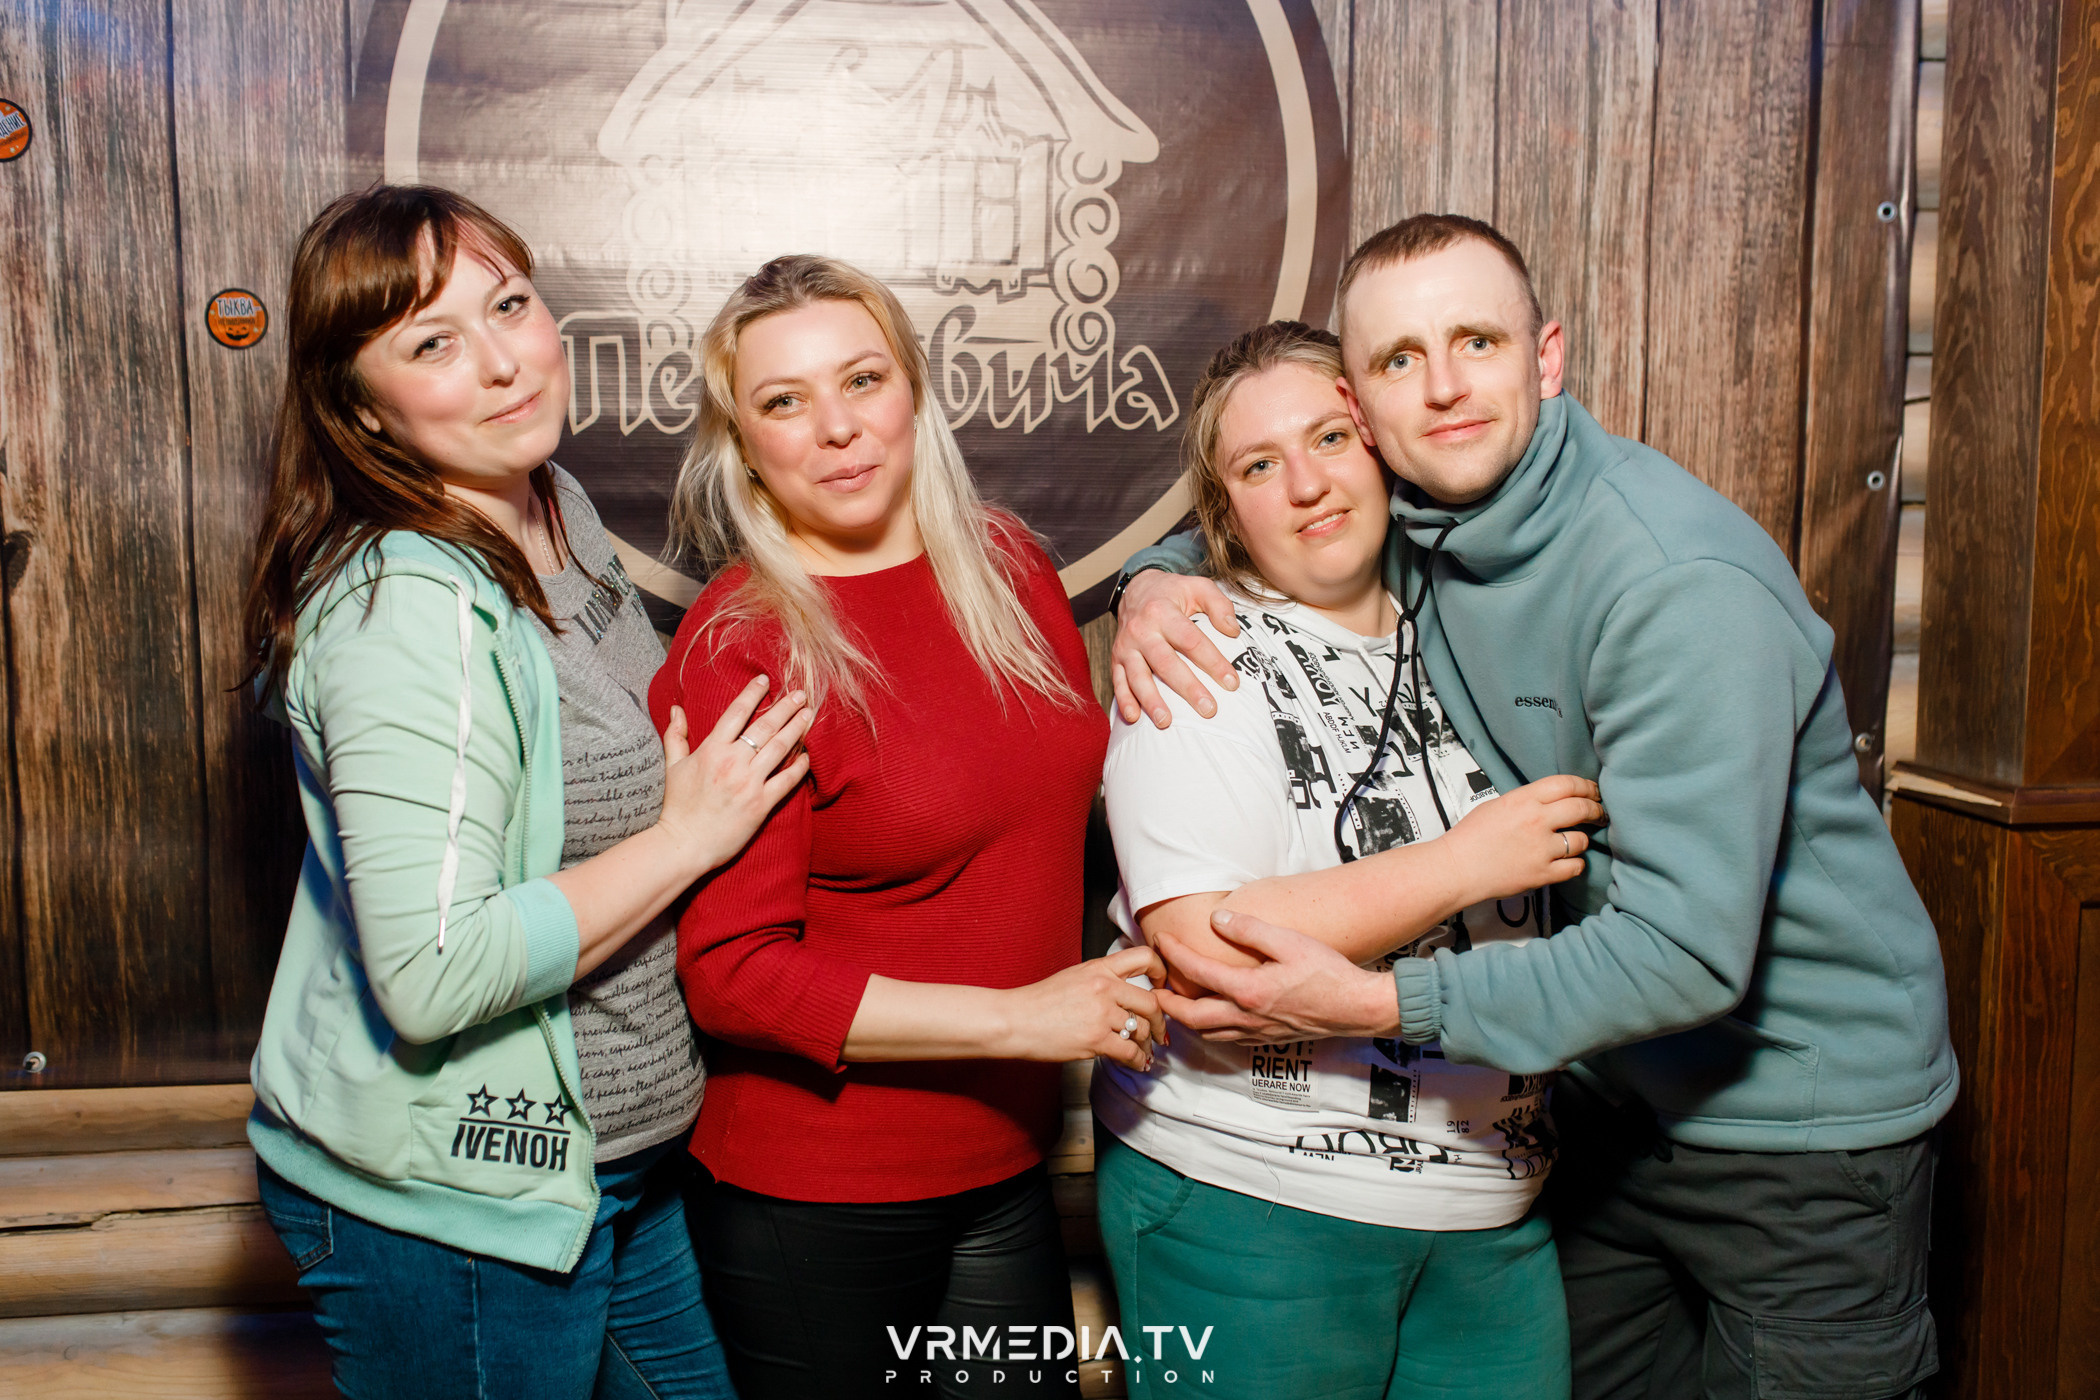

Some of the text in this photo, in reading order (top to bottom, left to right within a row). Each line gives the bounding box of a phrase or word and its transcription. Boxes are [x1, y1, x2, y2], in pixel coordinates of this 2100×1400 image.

[560, 303, 1181, 436] Певича
[1252, 1055, 1312, 1082] RIENT
[1252, 1079, 1311, 1093] UERARE NOW
[450, 1123, 570, 1172] IVENOH
